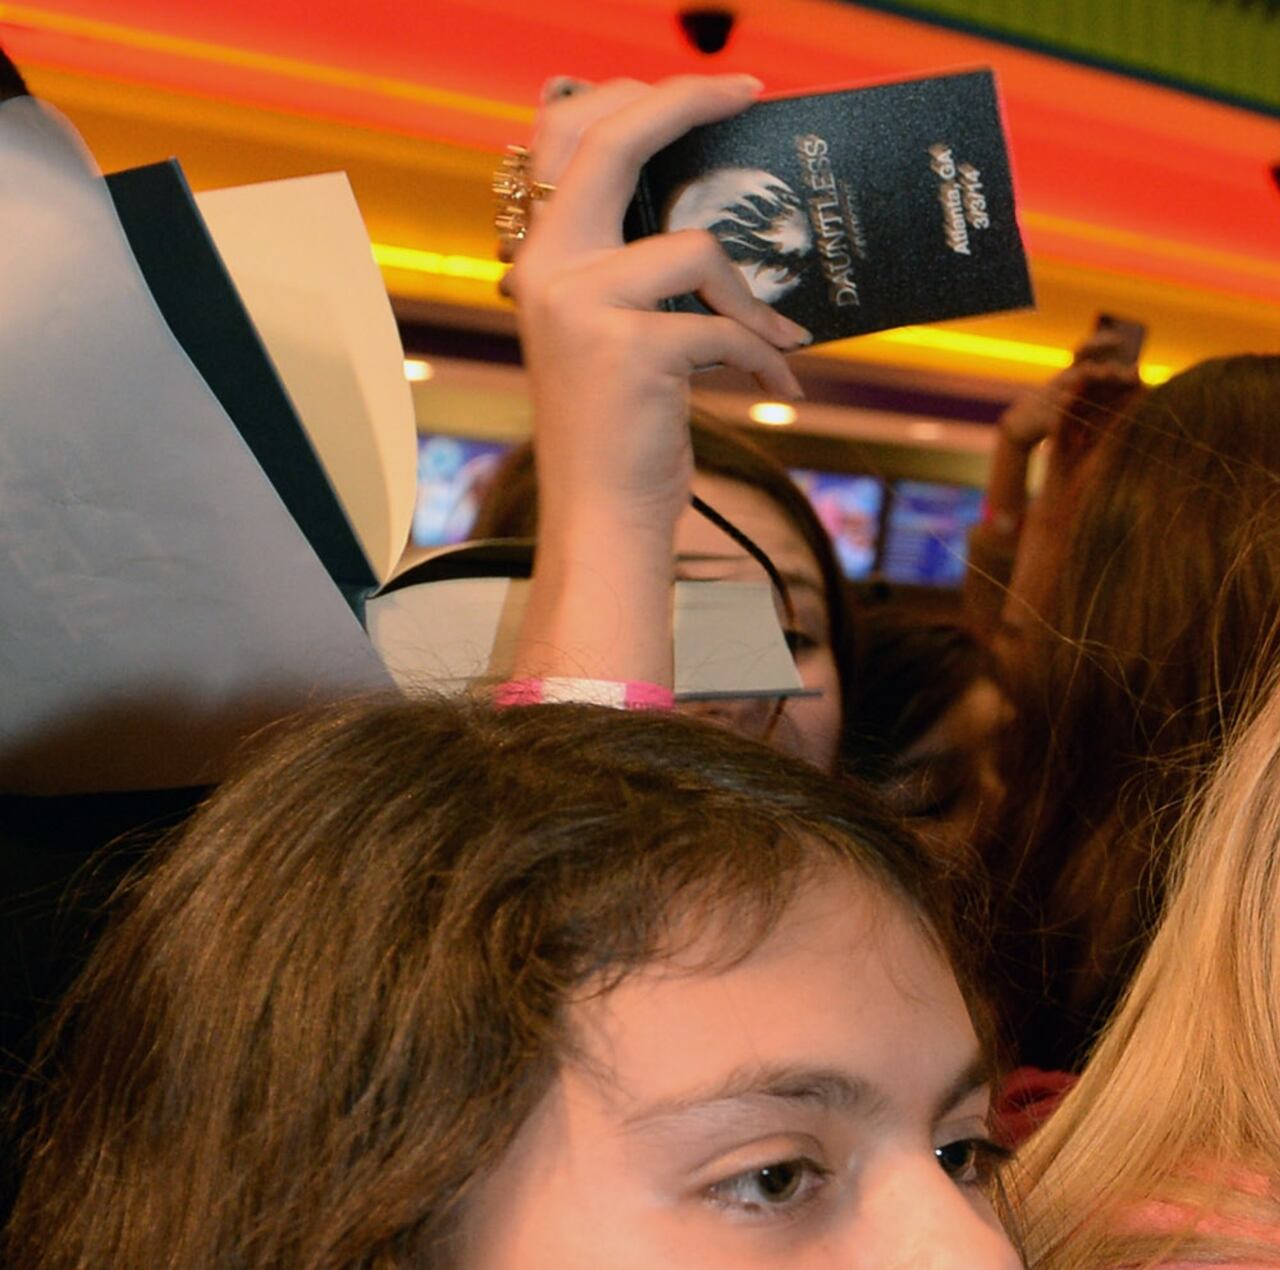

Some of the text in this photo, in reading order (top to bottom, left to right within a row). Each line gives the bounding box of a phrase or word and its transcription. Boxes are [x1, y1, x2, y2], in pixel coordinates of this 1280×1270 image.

[803, 138, 861, 307] DAUNTLESS
[936, 148, 971, 256] Atlanta, GA
[963, 169, 990, 230] 3/3/14
